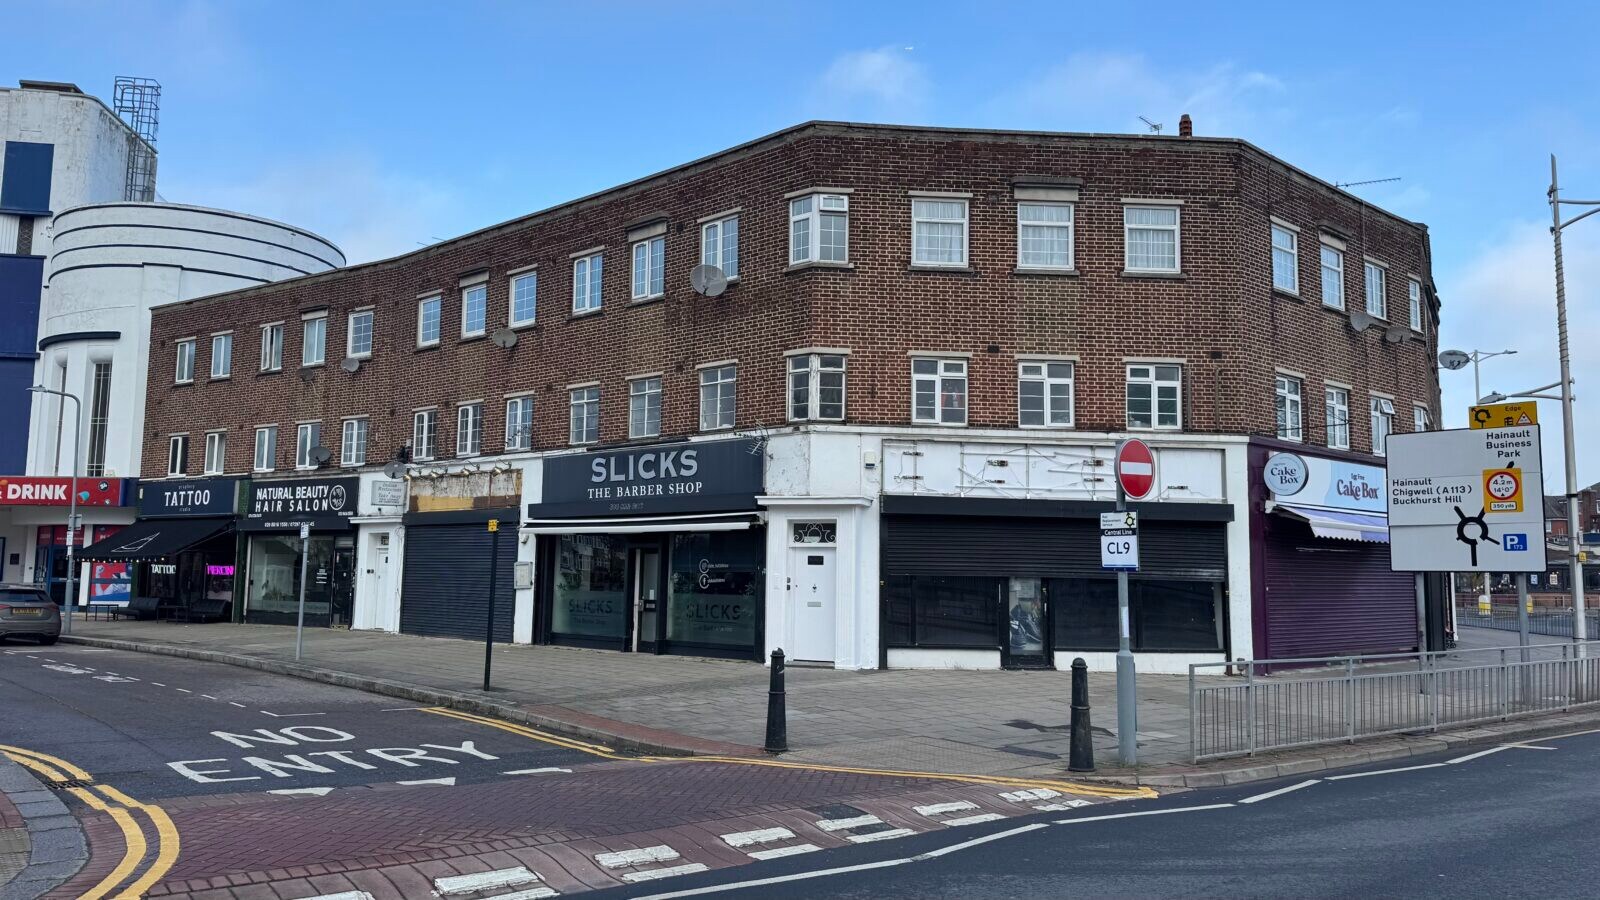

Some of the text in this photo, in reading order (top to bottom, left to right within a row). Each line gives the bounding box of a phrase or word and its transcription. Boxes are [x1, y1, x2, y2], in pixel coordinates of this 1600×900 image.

[1486, 430, 1531, 440] Hainault
[1486, 440, 1532, 450] Business
[1497, 450, 1521, 458] Park
[591, 449, 698, 483] SLICKS
[1270, 466, 1296, 477] Cake
[1279, 475, 1299, 485] Box
[1392, 478, 1432, 487] Hainault
[7, 483, 68, 500] DRINK
[256, 485, 329, 500] NATURAL BEAUTY
[588, 481, 703, 499] THE BARBER SHOP
[1337, 479, 1379, 500] Cake Box
[1392, 484, 1473, 497] Chigwell (A113)
[164, 489, 211, 507] TATTOO
[255, 498, 329, 513] HAIR SALON
[1392, 495, 1462, 505] Buckhurst Hill
[1107, 542, 1131, 554] CL9
[1506, 535, 1519, 549] P
[569, 598, 613, 614] SLICKS
[686, 602, 741, 620] SLICKS
[210, 726, 356, 748] NO
[166, 740, 500, 783] ENTRY
